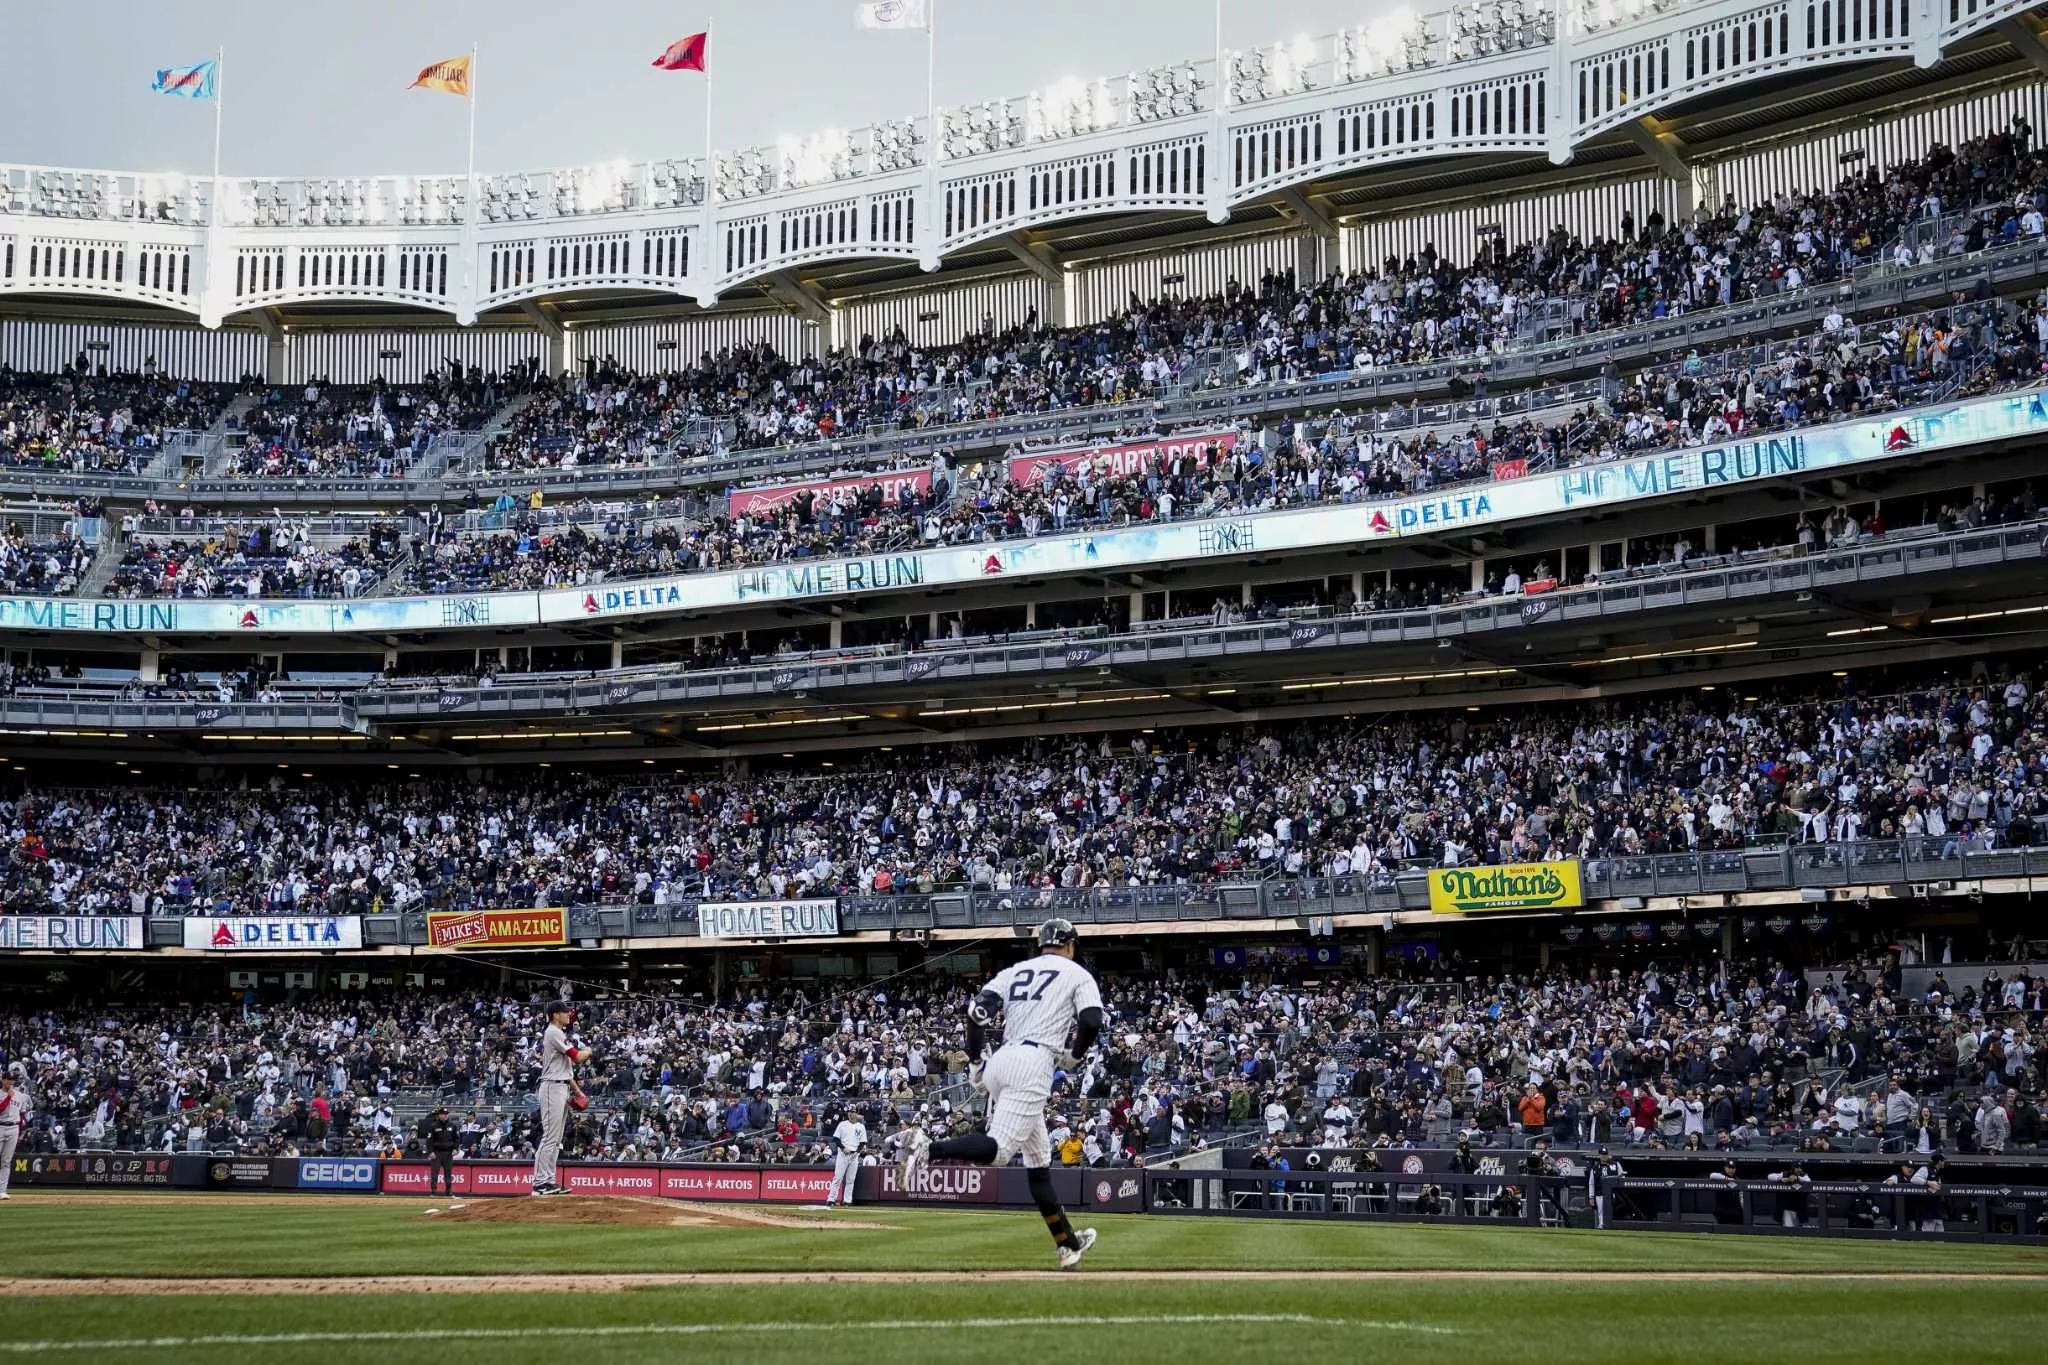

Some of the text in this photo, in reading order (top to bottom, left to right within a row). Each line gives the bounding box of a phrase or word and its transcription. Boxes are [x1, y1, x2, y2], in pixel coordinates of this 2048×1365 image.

[1563, 435, 1800, 506] HOME RUN
[1400, 495, 1492, 528] DELTA
[738, 556, 920, 599] HOME RUN
[606, 585, 681, 609] DELTA
[94, 602, 173, 630] RUN
[1291, 628, 1317, 640] 1938
[1067, 650, 1090, 661] 1937
[609, 687, 629, 699] 1928
[440, 695, 462, 706] 1927
[196, 709, 219, 720] 1923
[1442, 867, 1566, 900] Nathan's
[701, 904, 836, 936] HOME RUN
[47, 918, 126, 947] RUN
[244, 922, 341, 942] DELTA
[441, 918, 561, 942] MIKE'S AMAZING
[1009, 969, 1060, 1001] 27
[15, 1159, 28, 1172] M
[128, 1160, 141, 1172] P
[1332, 1156, 1351, 1168] OXI
[1480, 1157, 1500, 1169] OXI
[302, 1163, 373, 1183] GEICO
[388, 1173, 421, 1184] STELLA
[478, 1174, 512, 1184] STELLA
[571, 1176, 653, 1188] STELLA ARTOIS
[667, 1178, 753, 1190] STELLA ARTOIS
[767, 1178, 832, 1191] STELLA ARTO
[883, 1168, 981, 1194] HIRCLUB
